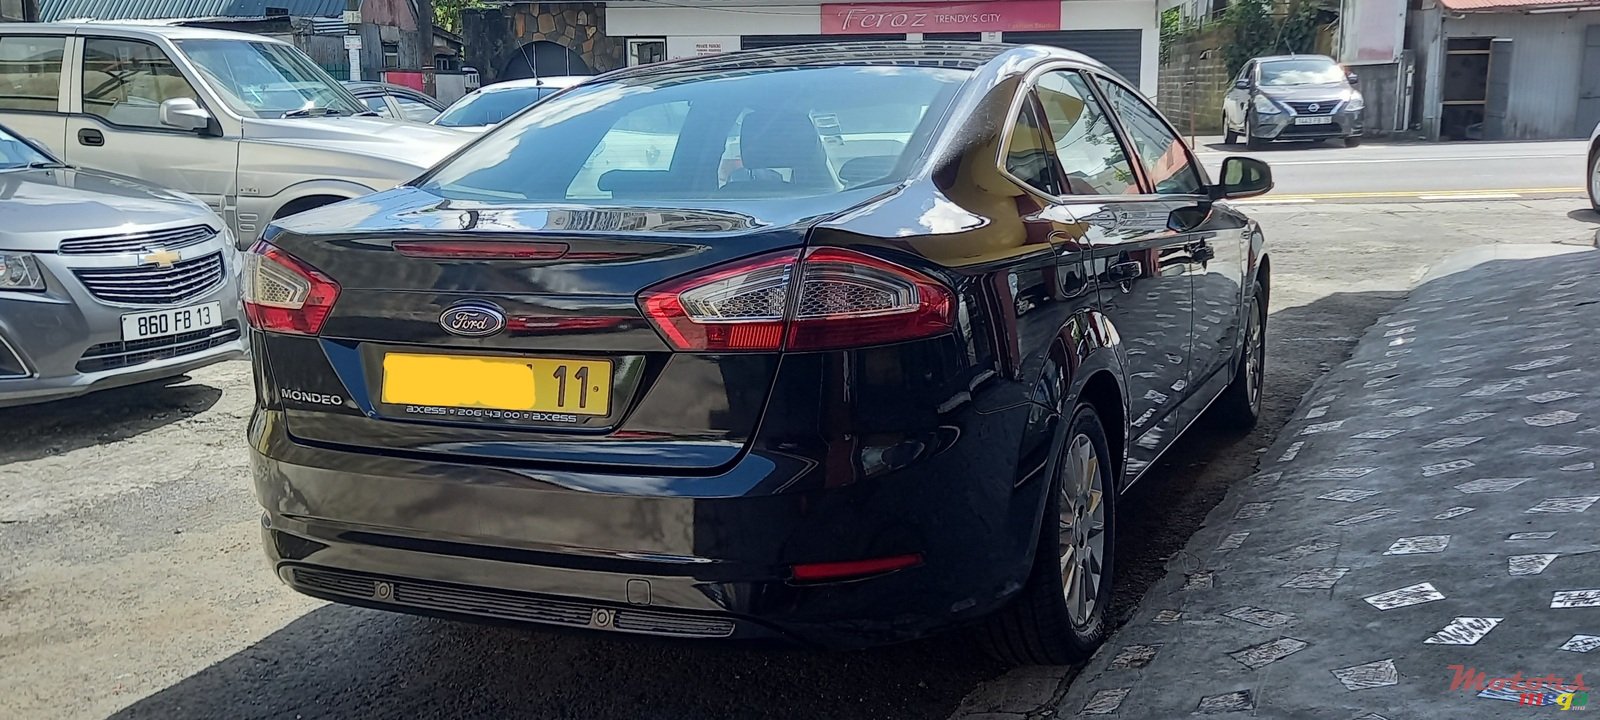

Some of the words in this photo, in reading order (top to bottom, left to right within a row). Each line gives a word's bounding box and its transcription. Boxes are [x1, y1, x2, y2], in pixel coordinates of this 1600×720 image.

[838, 9, 928, 30] Feroz
[934, 13, 978, 24] TRENDY'S
[980, 13, 1001, 23] CITY
[138, 314, 168, 336] 860
[175, 310, 191, 331] FB
[196, 306, 211, 327] 13
[452, 311, 488, 330] Ford
[552, 364, 589, 409] 11
[281, 388, 343, 405] MONDEO
[405, 405, 447, 415] axess
[457, 409, 482, 418] 206
[484, 409, 502, 418] 43
[503, 410, 520, 419] 00
[532, 412, 577, 424] axess
